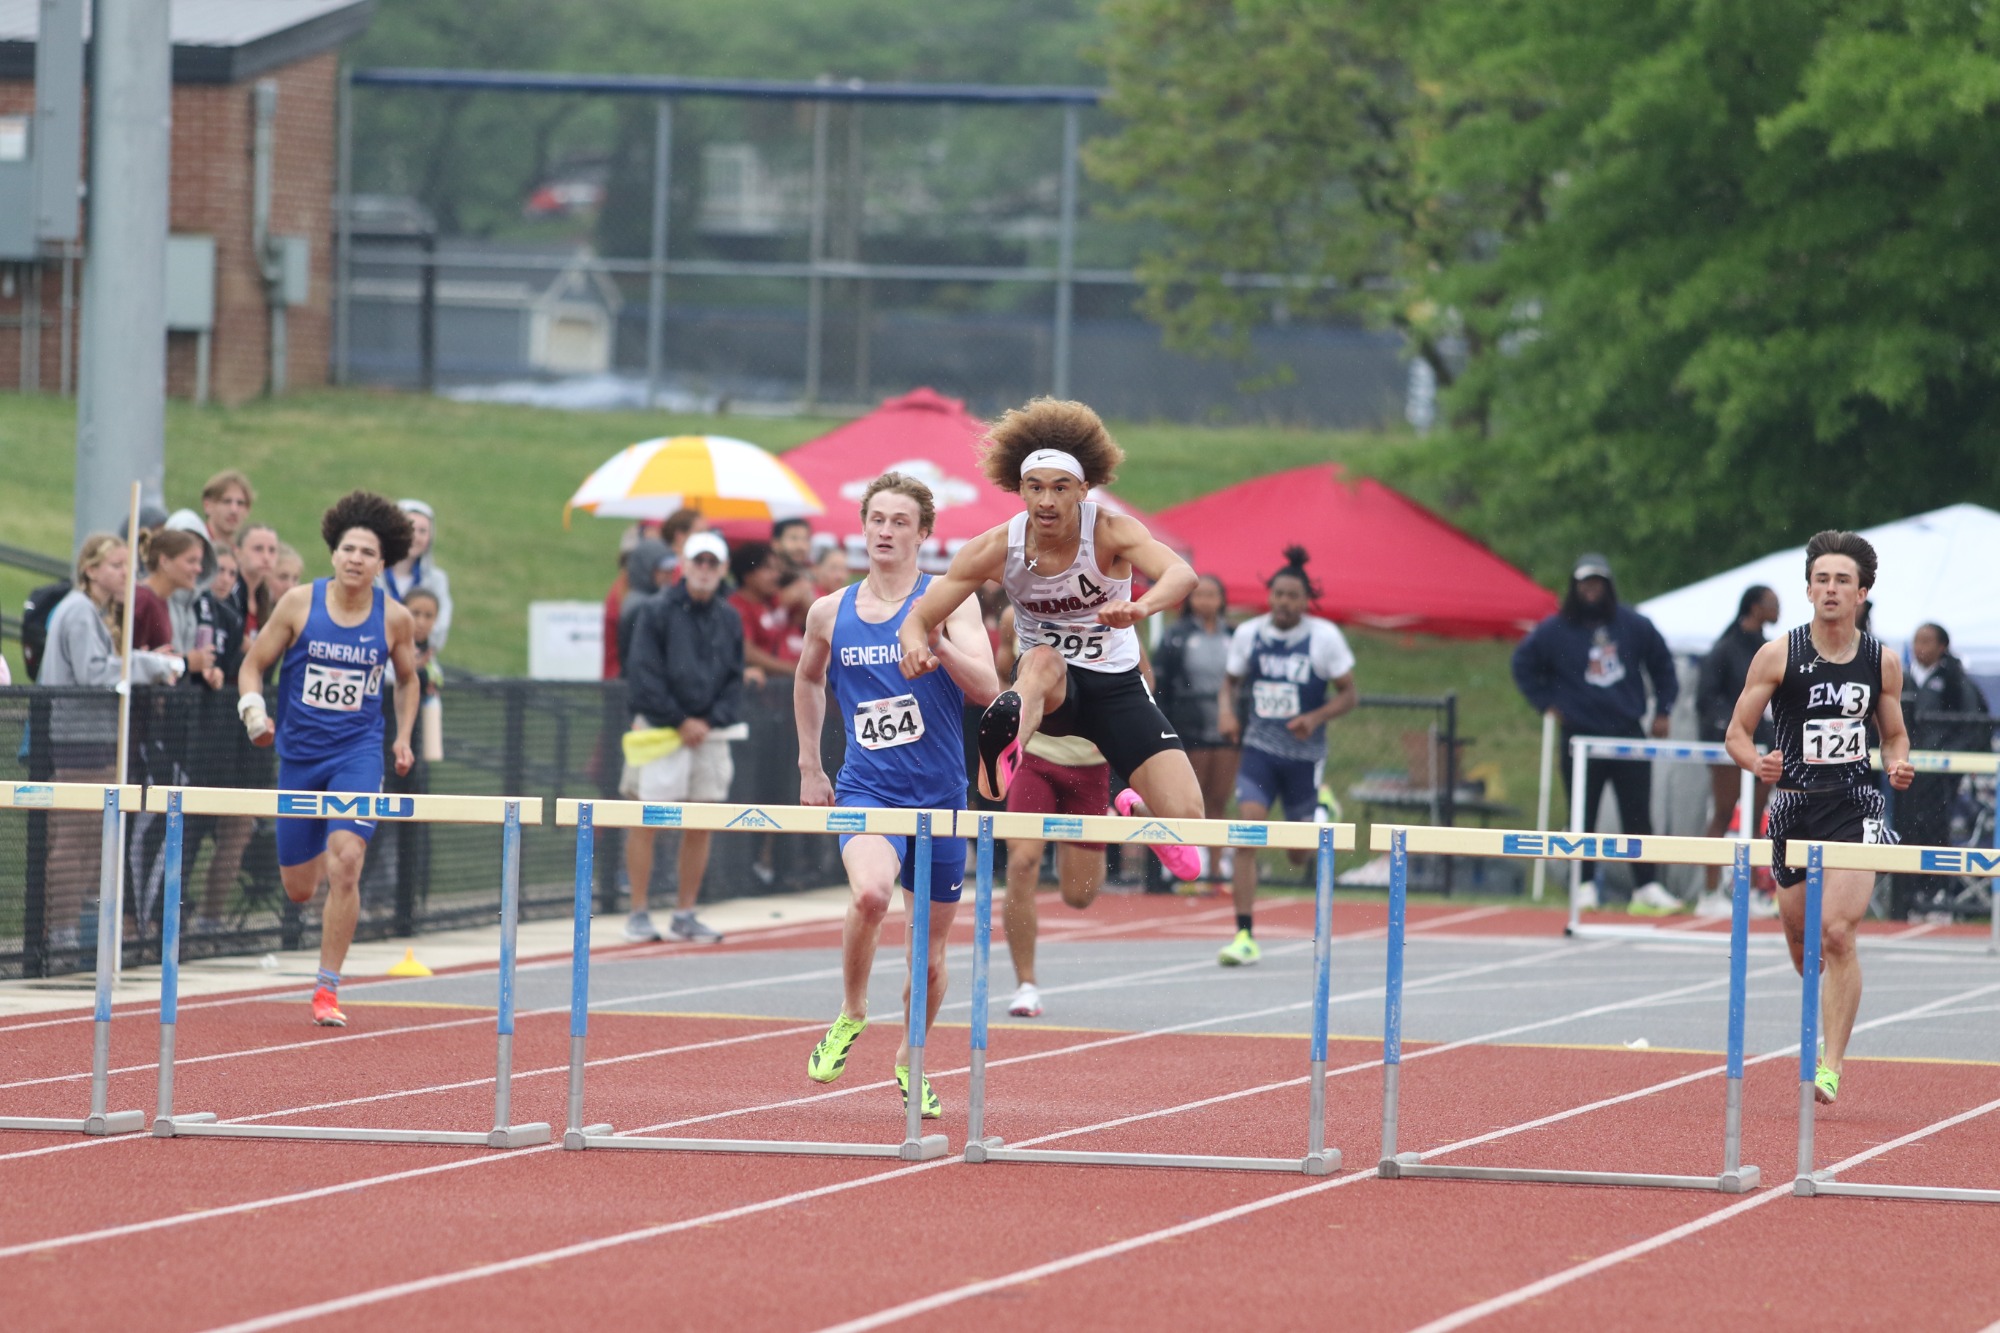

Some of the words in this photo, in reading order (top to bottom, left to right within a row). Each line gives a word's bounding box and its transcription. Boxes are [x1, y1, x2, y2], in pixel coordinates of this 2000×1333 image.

[1078, 574, 1102, 598] 4
[308, 640, 378, 665] GENERALS
[840, 643, 904, 667] GENERAL
[1043, 632, 1104, 660] 295
[308, 680, 357, 706] 468
[1806, 682, 1847, 709] EM
[1846, 685, 1865, 715] 3
[861, 710, 918, 743] 464
[1810, 732, 1860, 759] 124
[277, 793, 415, 818] EMU
[1867, 820, 1881, 844] 3
[1502, 833, 1643, 859] EMU
[1920, 849, 2000, 873] EM
